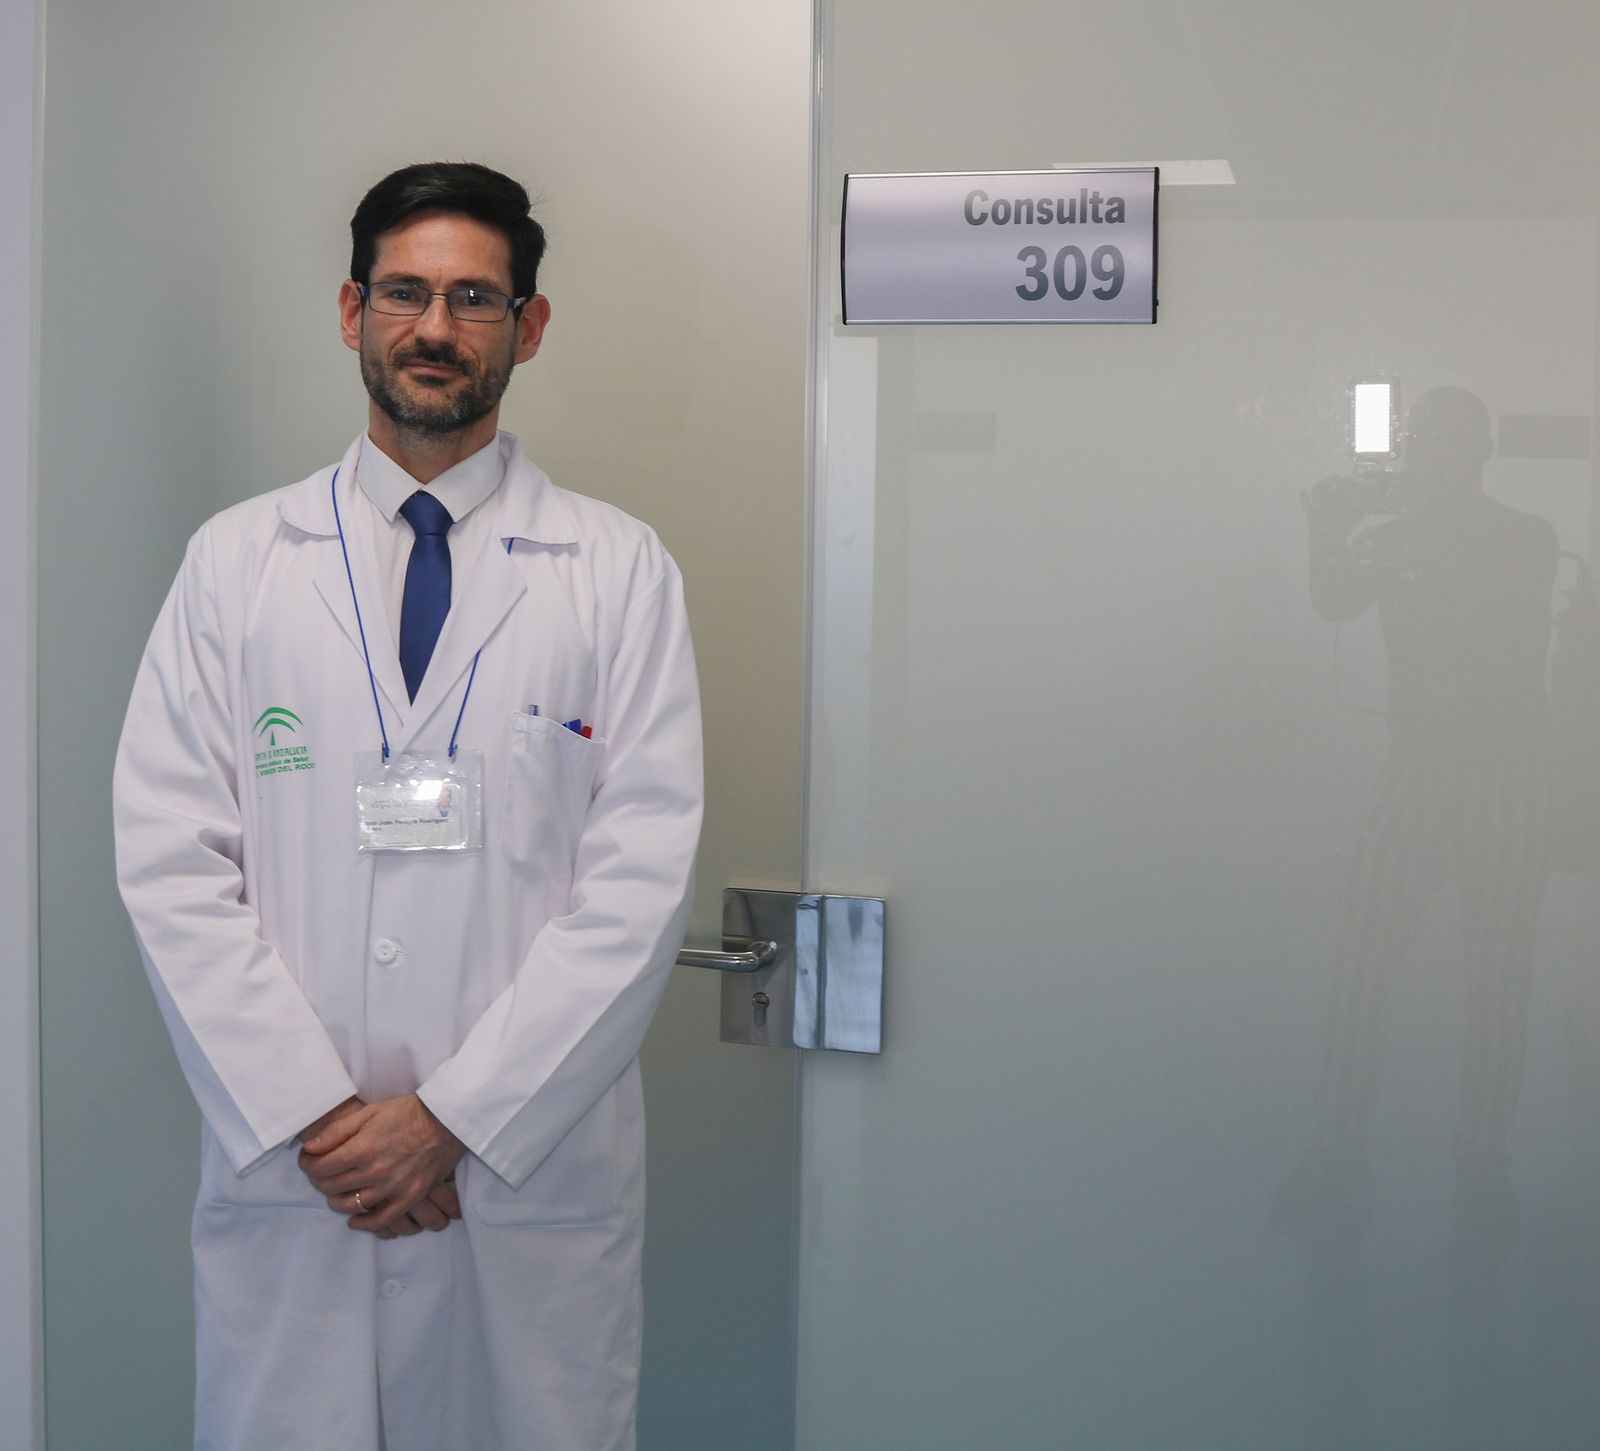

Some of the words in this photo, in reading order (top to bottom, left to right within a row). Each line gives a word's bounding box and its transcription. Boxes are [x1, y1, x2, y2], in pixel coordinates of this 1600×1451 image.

[964, 188, 1125, 226] Consulta
[1015, 245, 1125, 301] 309
[277, 765, 294, 773] DEL
[294, 762, 316, 771] ROC
